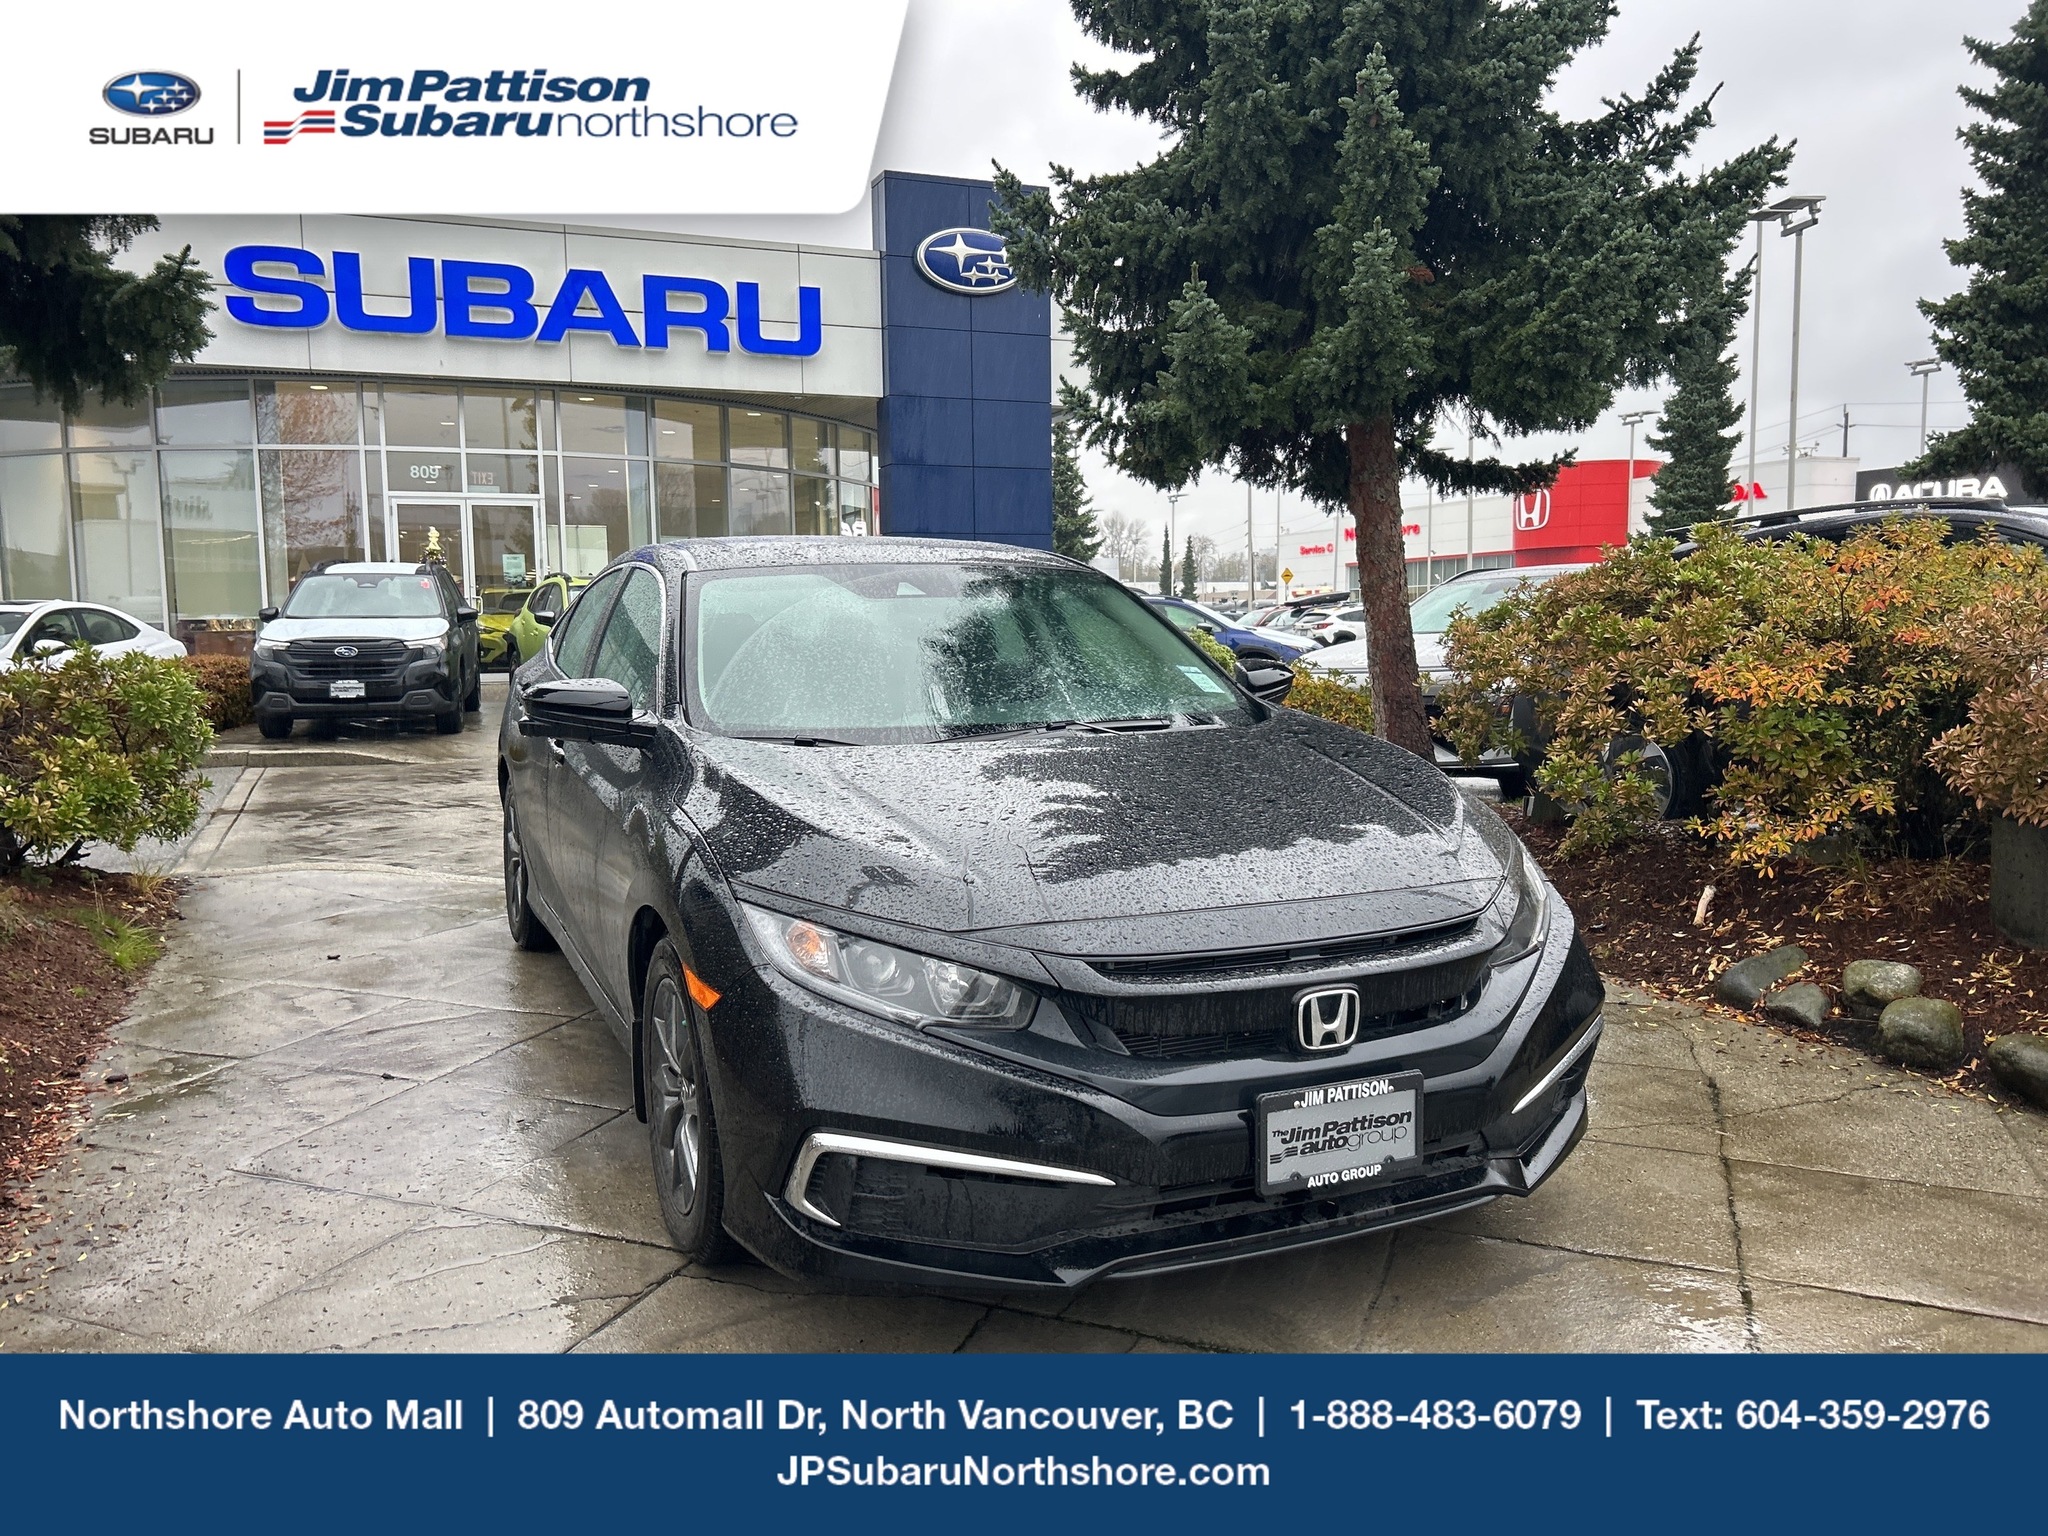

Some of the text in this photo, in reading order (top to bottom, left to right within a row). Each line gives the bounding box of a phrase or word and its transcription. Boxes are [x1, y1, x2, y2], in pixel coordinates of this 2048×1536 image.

[224, 245, 822, 357] SUBARU
[410, 465, 440, 479] 809
[1894, 476, 2009, 499] ACURA
[1300, 545, 1326, 556] Service
[1300, 1079, 1389, 1108] JIM PATTISON
[1272, 1110, 1413, 1145] The Jim Pattison
[1307, 1164, 1383, 1188] AUTO GROUP
